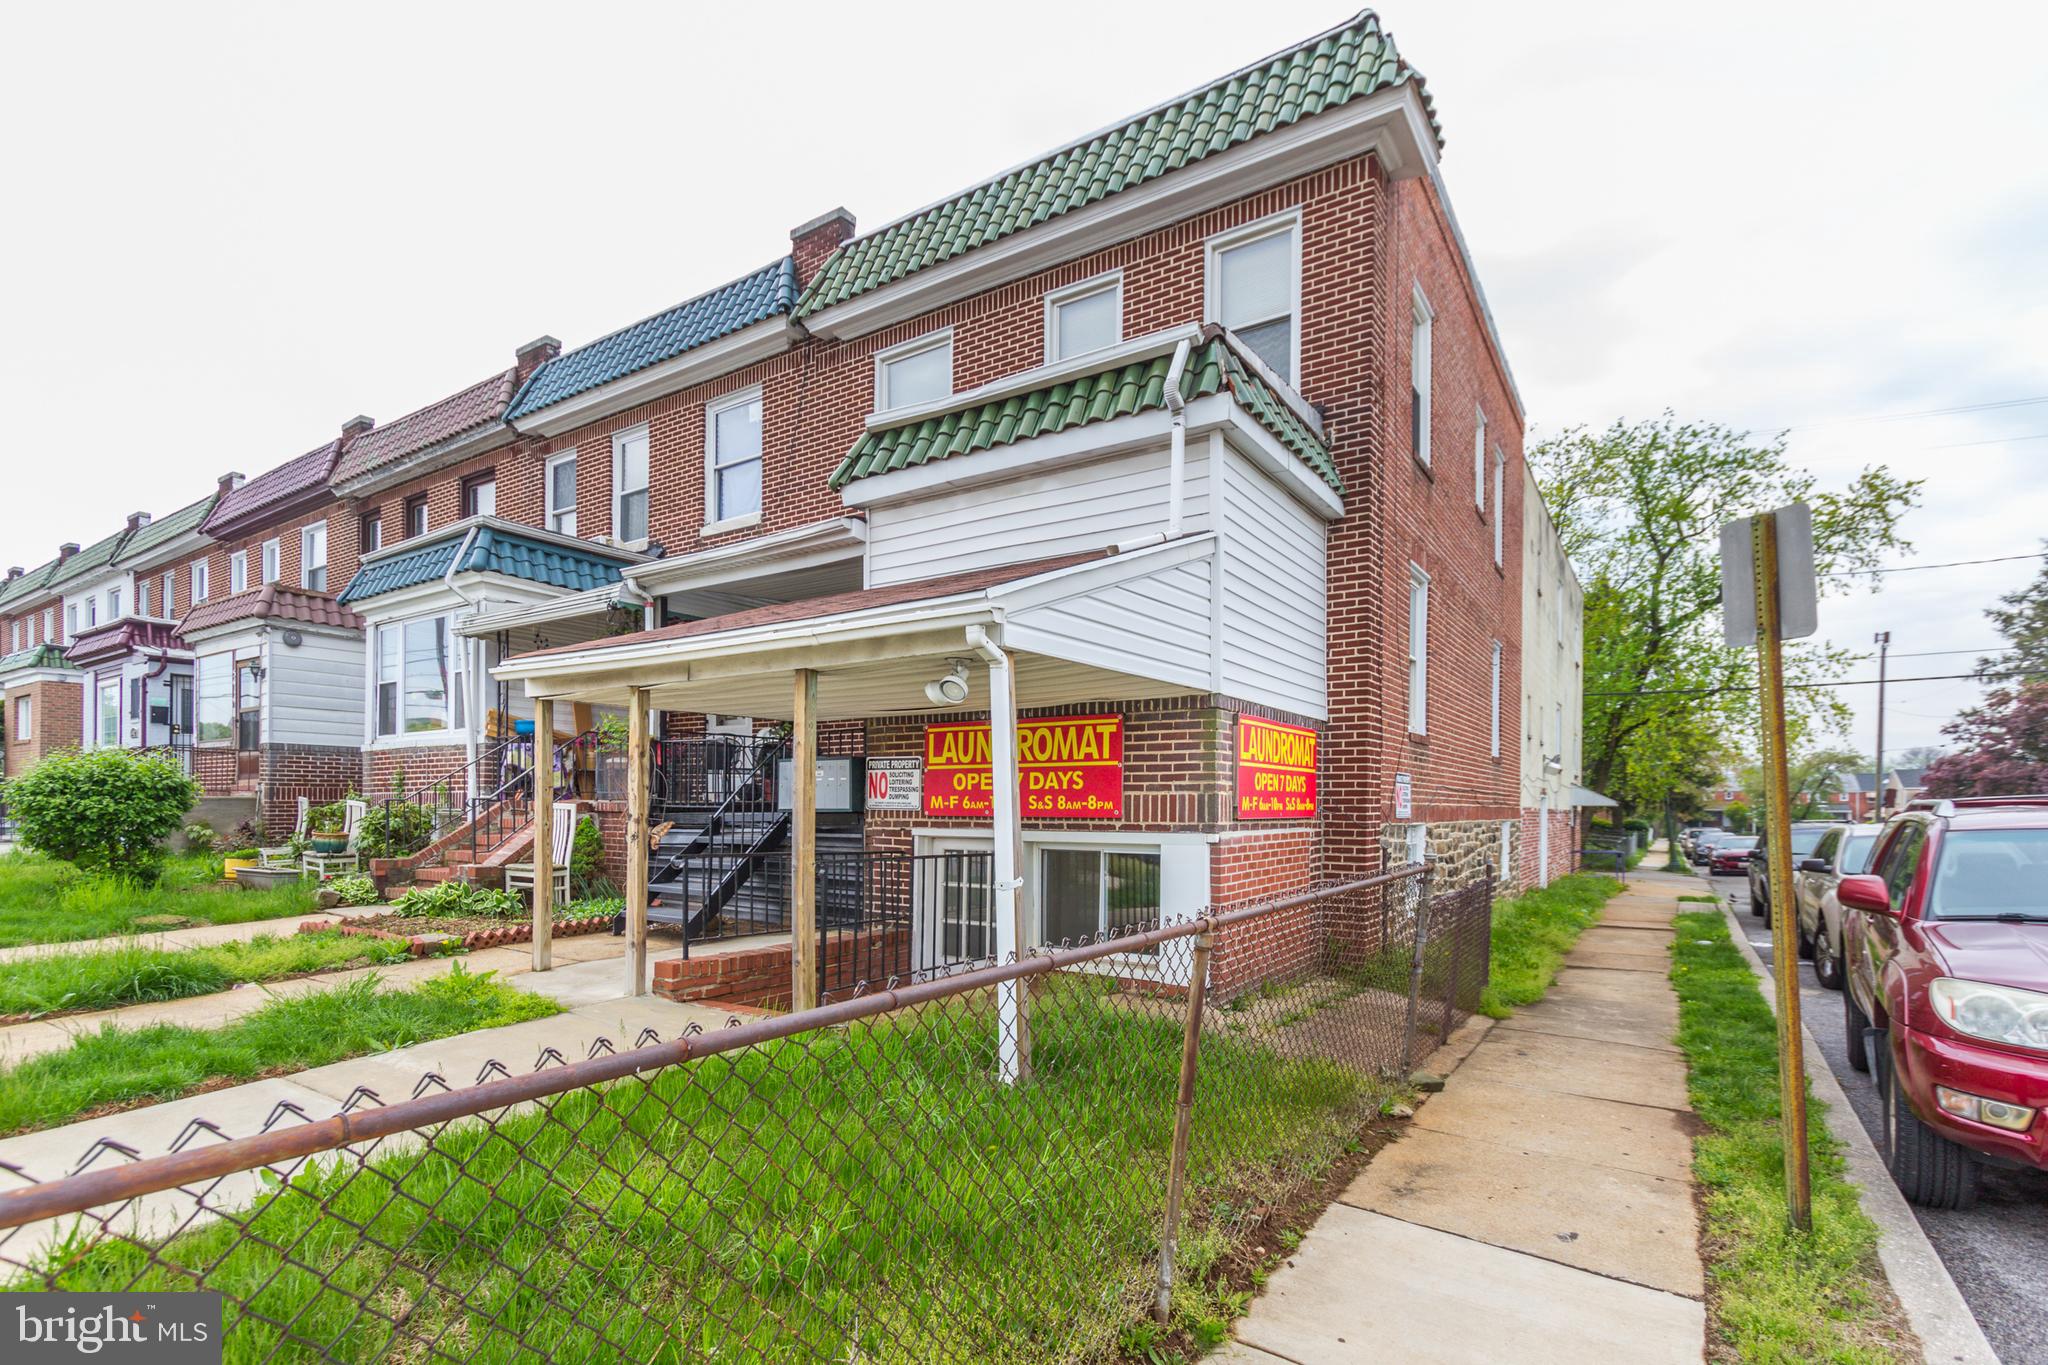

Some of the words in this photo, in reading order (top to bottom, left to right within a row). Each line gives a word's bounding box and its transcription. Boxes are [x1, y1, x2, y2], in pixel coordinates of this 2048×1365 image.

[929, 724, 1117, 764] LAUNROMAT
[1240, 724, 1316, 768] LAUNDROMAT
[868, 760, 890, 769] PRIVATE
[891, 760, 920, 769] PROPERTY
[868, 771, 889, 800] NO
[953, 772, 993, 791] OPE
[1029, 770, 1084, 790] DAYS
[1254, 772, 1279, 792] OPEN
[1279, 775, 1285, 792] 7
[1285, 775, 1307, 793] DAYS
[930, 795, 959, 809] M-F
[1028, 795, 1053, 810] S&S
[1057, 795, 1114, 810] 8AM-8PM
[1241, 796, 1258, 811] M-F
